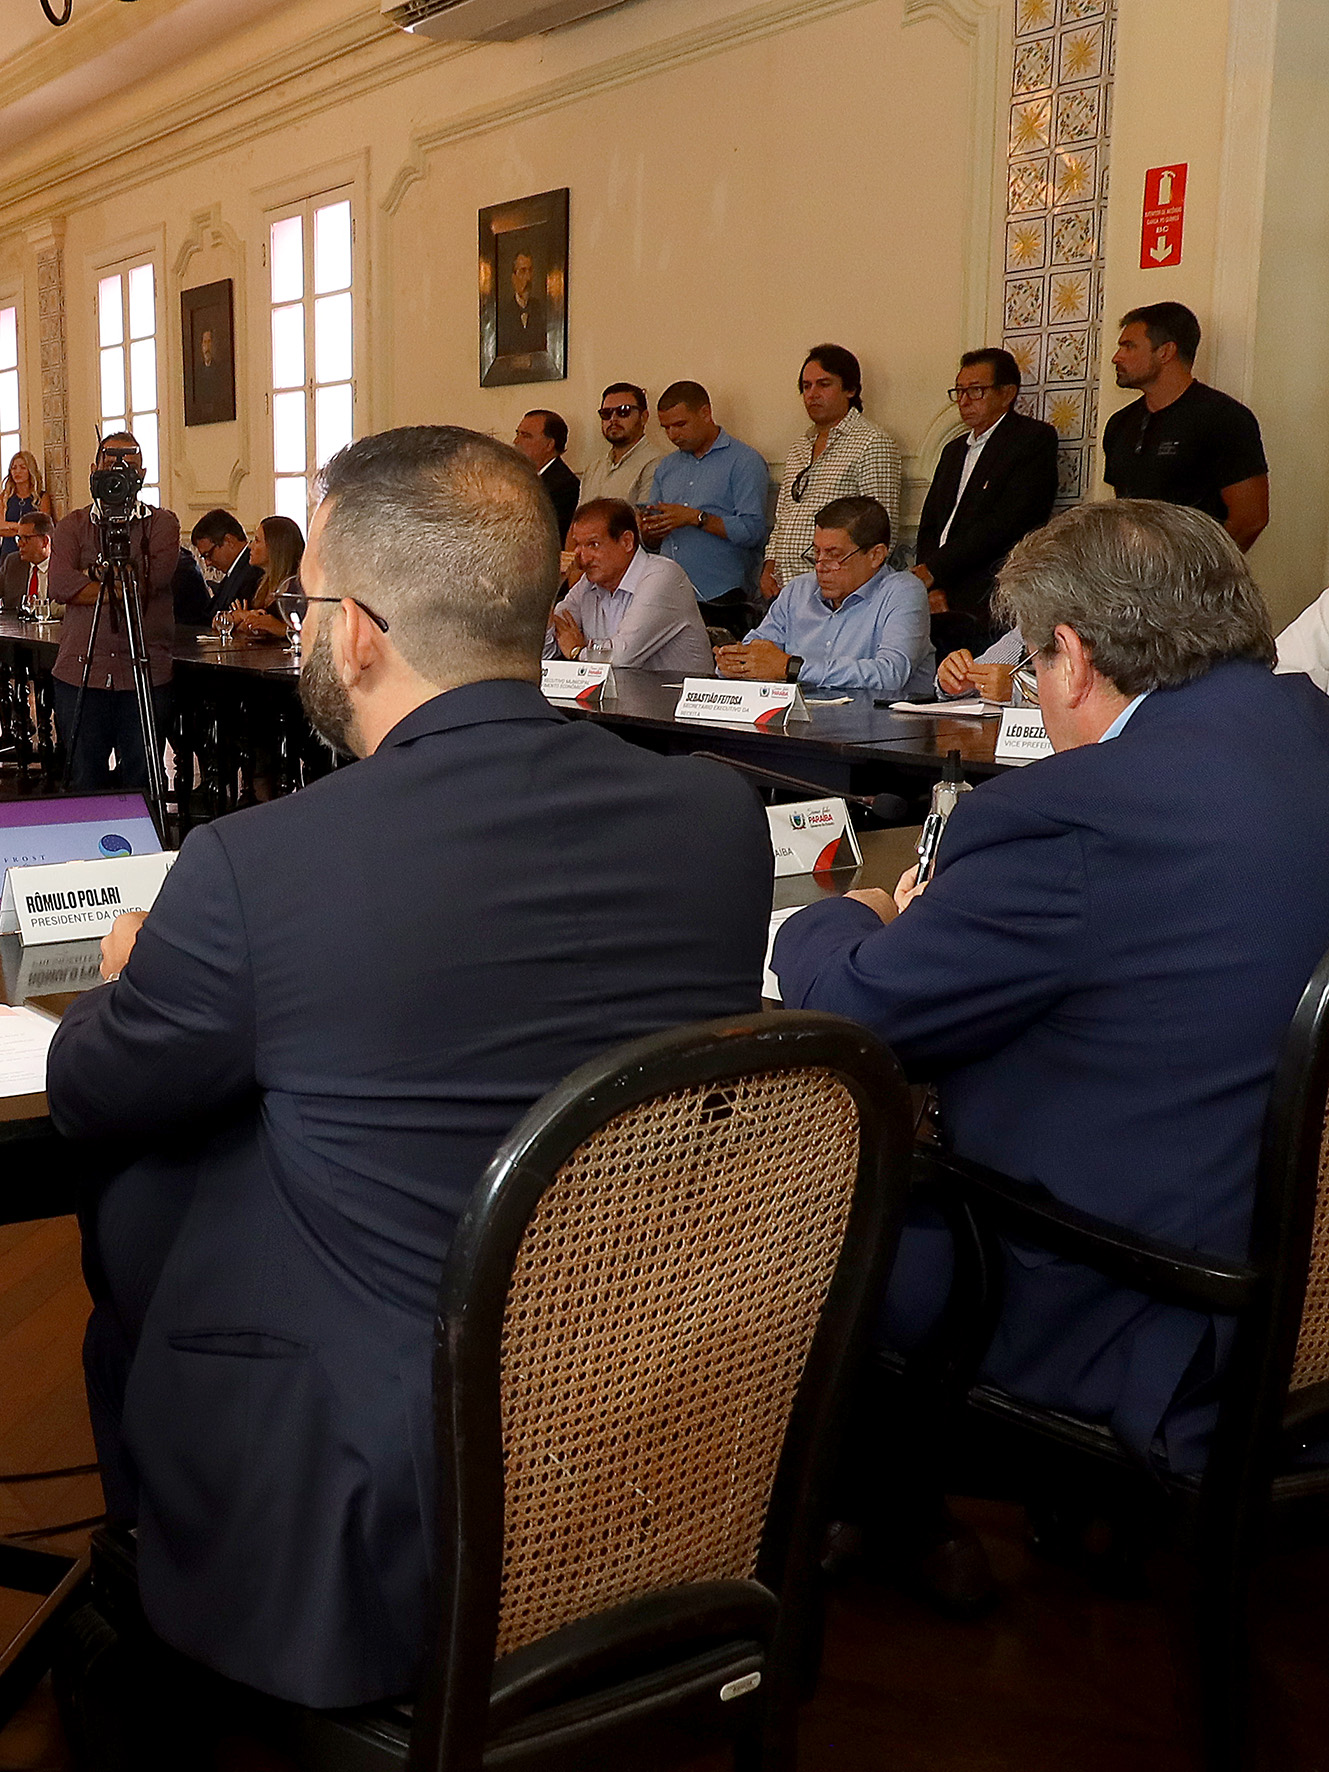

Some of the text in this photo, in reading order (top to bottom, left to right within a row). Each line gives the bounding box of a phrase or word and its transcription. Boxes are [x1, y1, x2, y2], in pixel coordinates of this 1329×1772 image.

[685, 692, 743, 705] SEBASTIÃO FEITOSA
[1006, 723, 1022, 737] LÉO
[3, 854, 46, 863] FROST
[25, 886, 121, 913] RÔMULO POLARI
[31, 911, 95, 928] PRESIDENTE
[96, 910, 111, 920] DA
